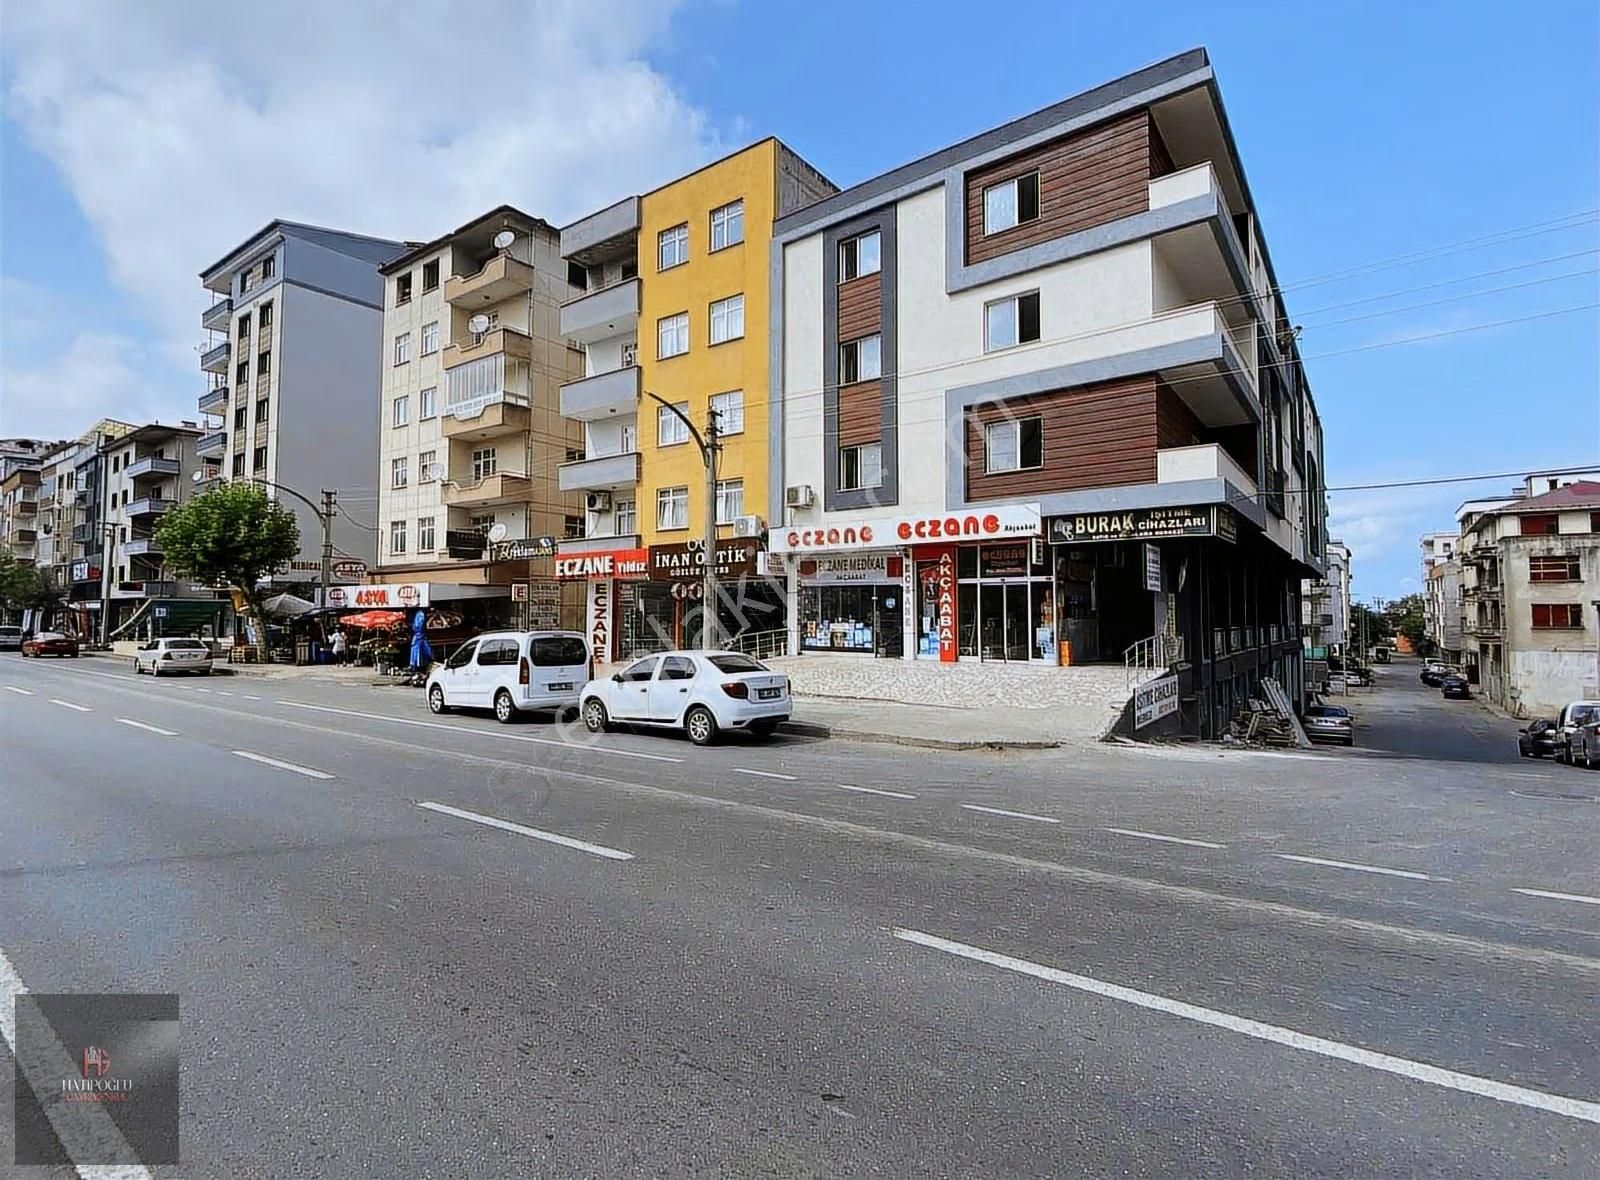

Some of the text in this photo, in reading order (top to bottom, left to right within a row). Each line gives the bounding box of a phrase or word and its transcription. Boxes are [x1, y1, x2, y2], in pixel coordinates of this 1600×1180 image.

[896, 513, 1001, 540] eczane
[1075, 512, 1134, 534] BURAK
[1138, 516, 1206, 530] CİHAZLARI
[787, 525, 874, 548] eczane
[555, 556, 646, 577] ECZANE Yıldız
[655, 552, 690, 568] İNAN
[695, 545, 746, 565] OTİK
[335, 564, 365, 572] ASYA
[355, 590, 389, 606] ASYA
[939, 553, 952, 651] AKÇAABAT
[593, 583, 607, 663] ECZANE
